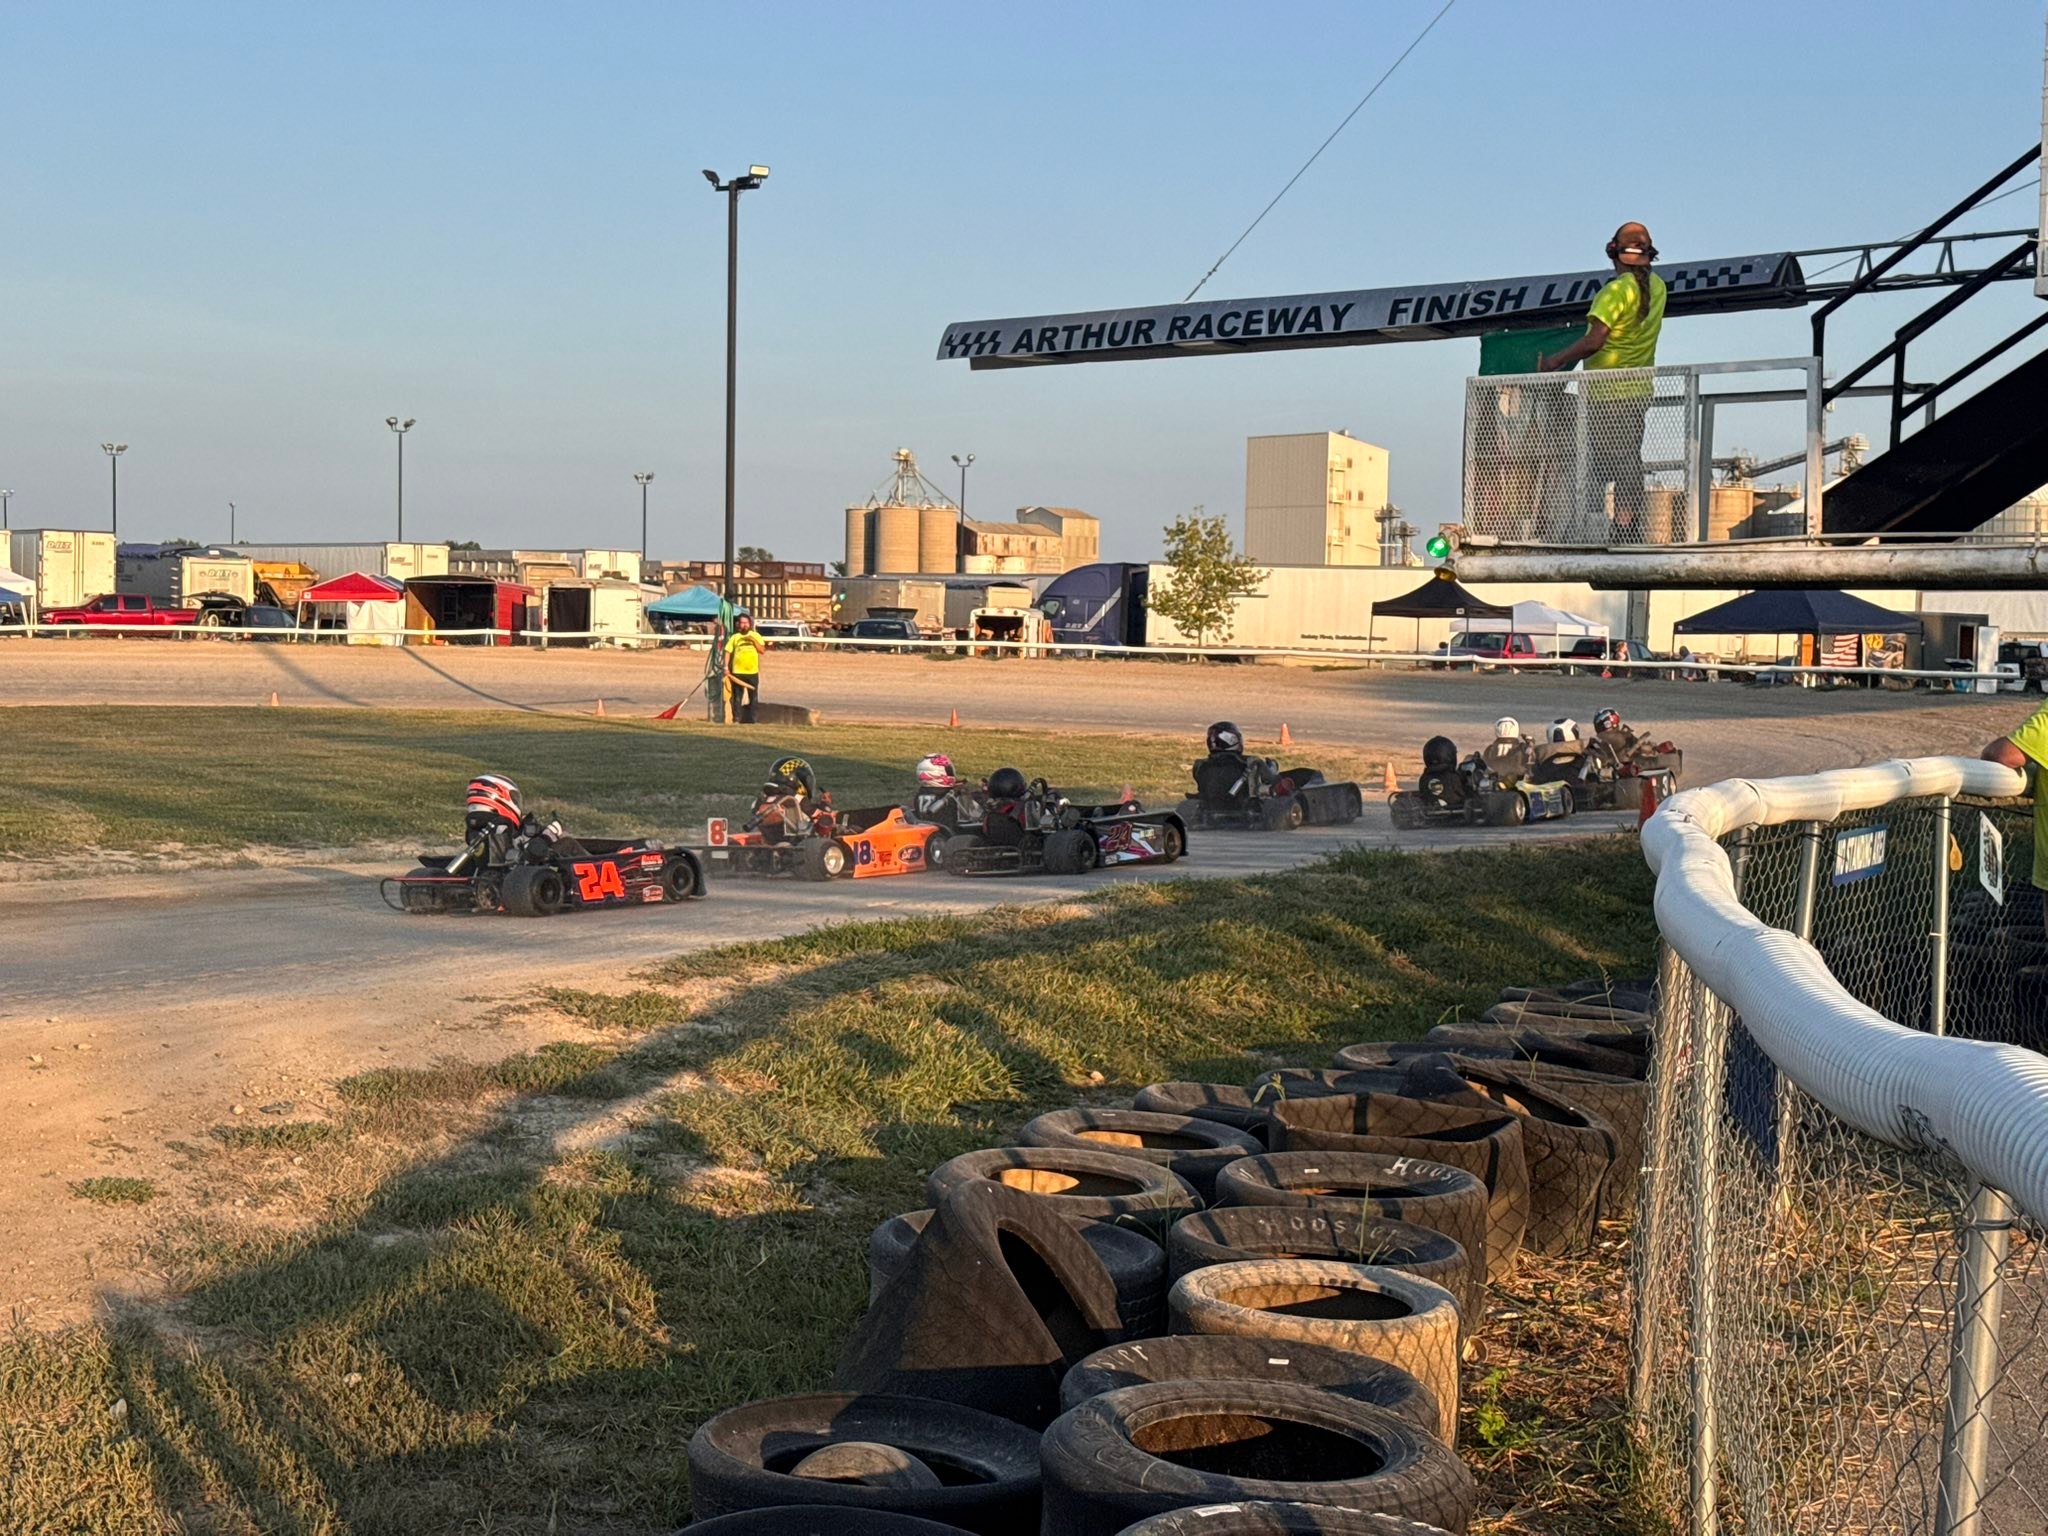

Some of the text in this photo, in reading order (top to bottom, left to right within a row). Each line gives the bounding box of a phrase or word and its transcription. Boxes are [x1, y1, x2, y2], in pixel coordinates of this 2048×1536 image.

[1010, 276, 1616, 353] ARTHUR RACEWAY FINISH LIN
[573, 861, 625, 901] 24
